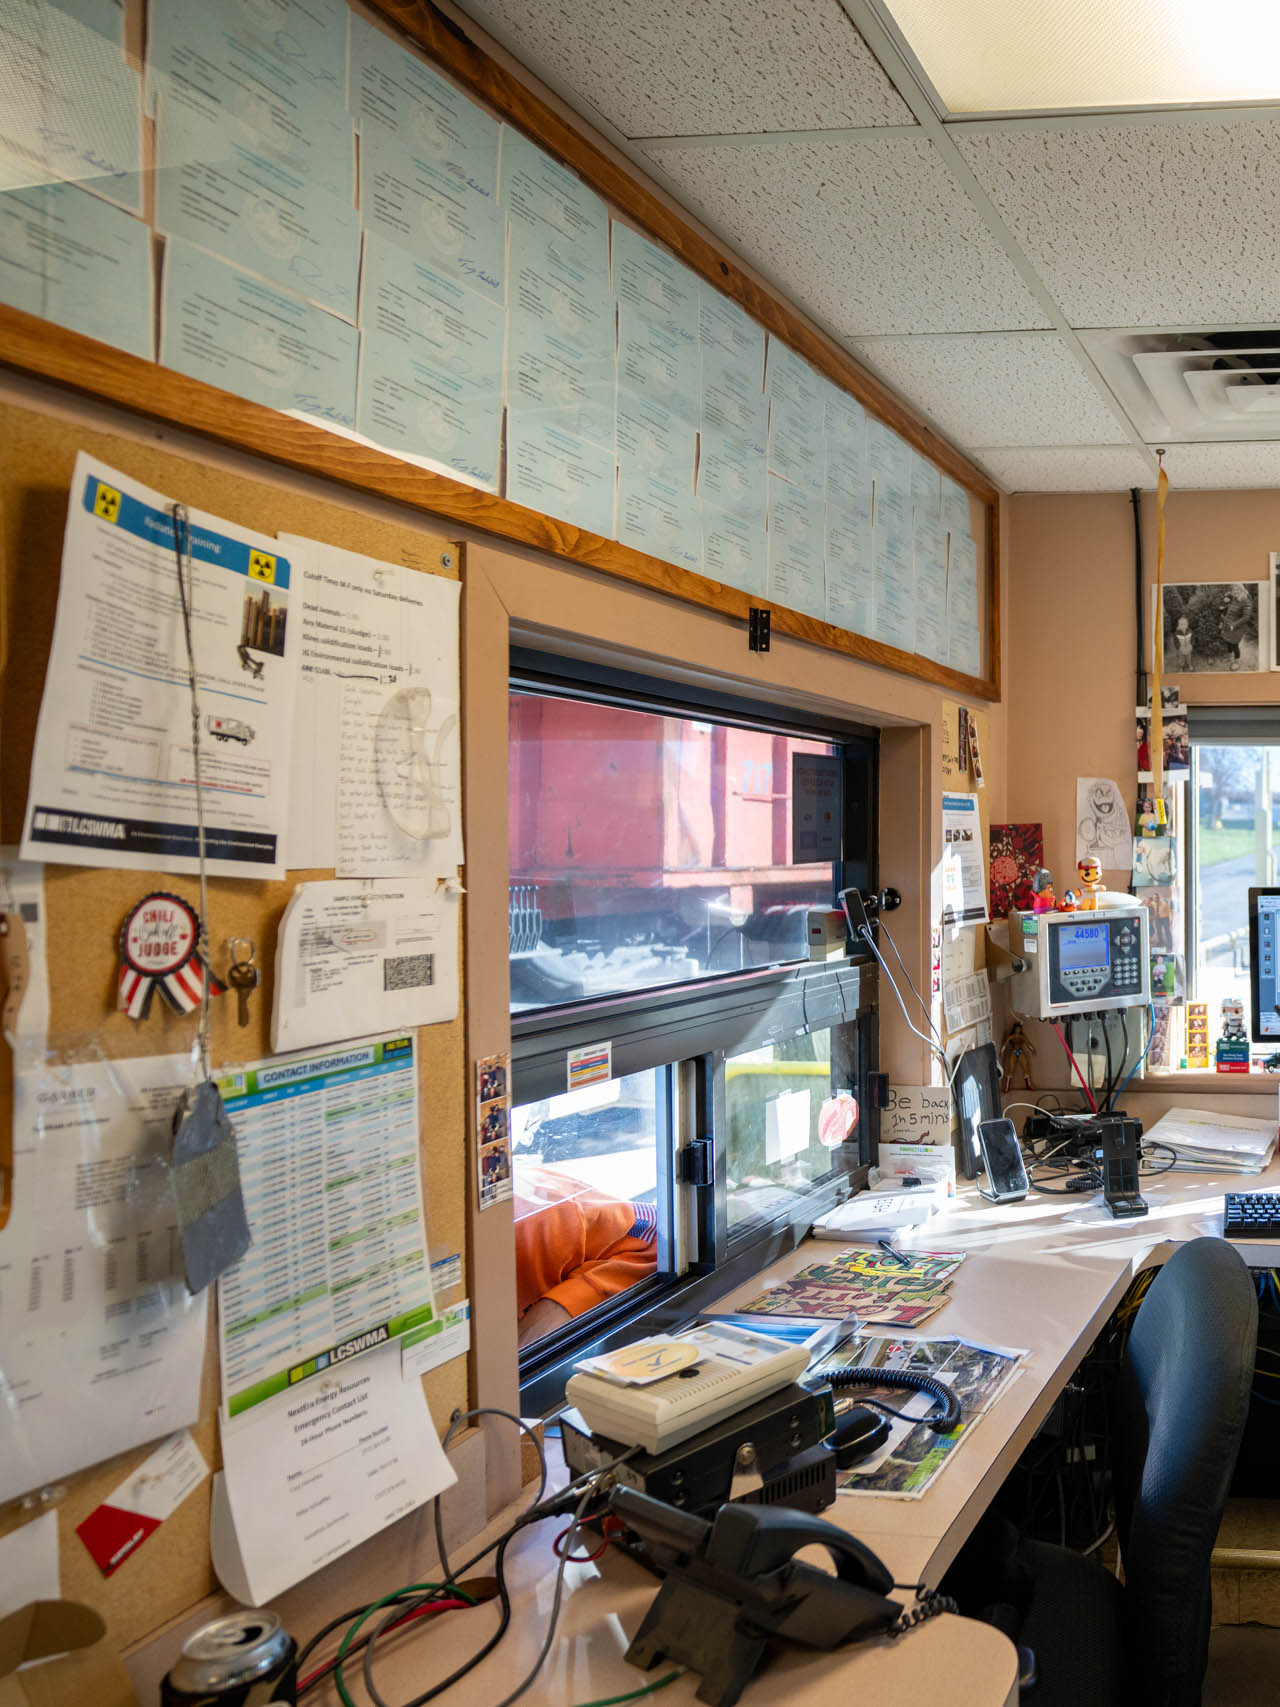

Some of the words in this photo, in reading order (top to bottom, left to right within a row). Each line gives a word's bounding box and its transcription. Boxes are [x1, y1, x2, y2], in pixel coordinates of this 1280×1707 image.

[742, 760, 772, 793] 717
[143, 910, 174, 923] CHILI
[138, 941, 178, 957] JUDGE
[264, 1067, 308, 1083] CONTACT
[309, 1051, 369, 1073] INFORMATION
[884, 1089, 912, 1111] Be
[909, 1113, 918, 1125] 5
[330, 1327, 388, 1364] LCSWMA
[288, 1400, 315, 1418] NextEra
[315, 1391, 338, 1406] Energy
[339, 1376, 371, 1393] Resources
[294, 1410, 331, 1432] Emergency
[331, 1398, 356, 1415] Contact
[357, 1392, 369, 1402] List
